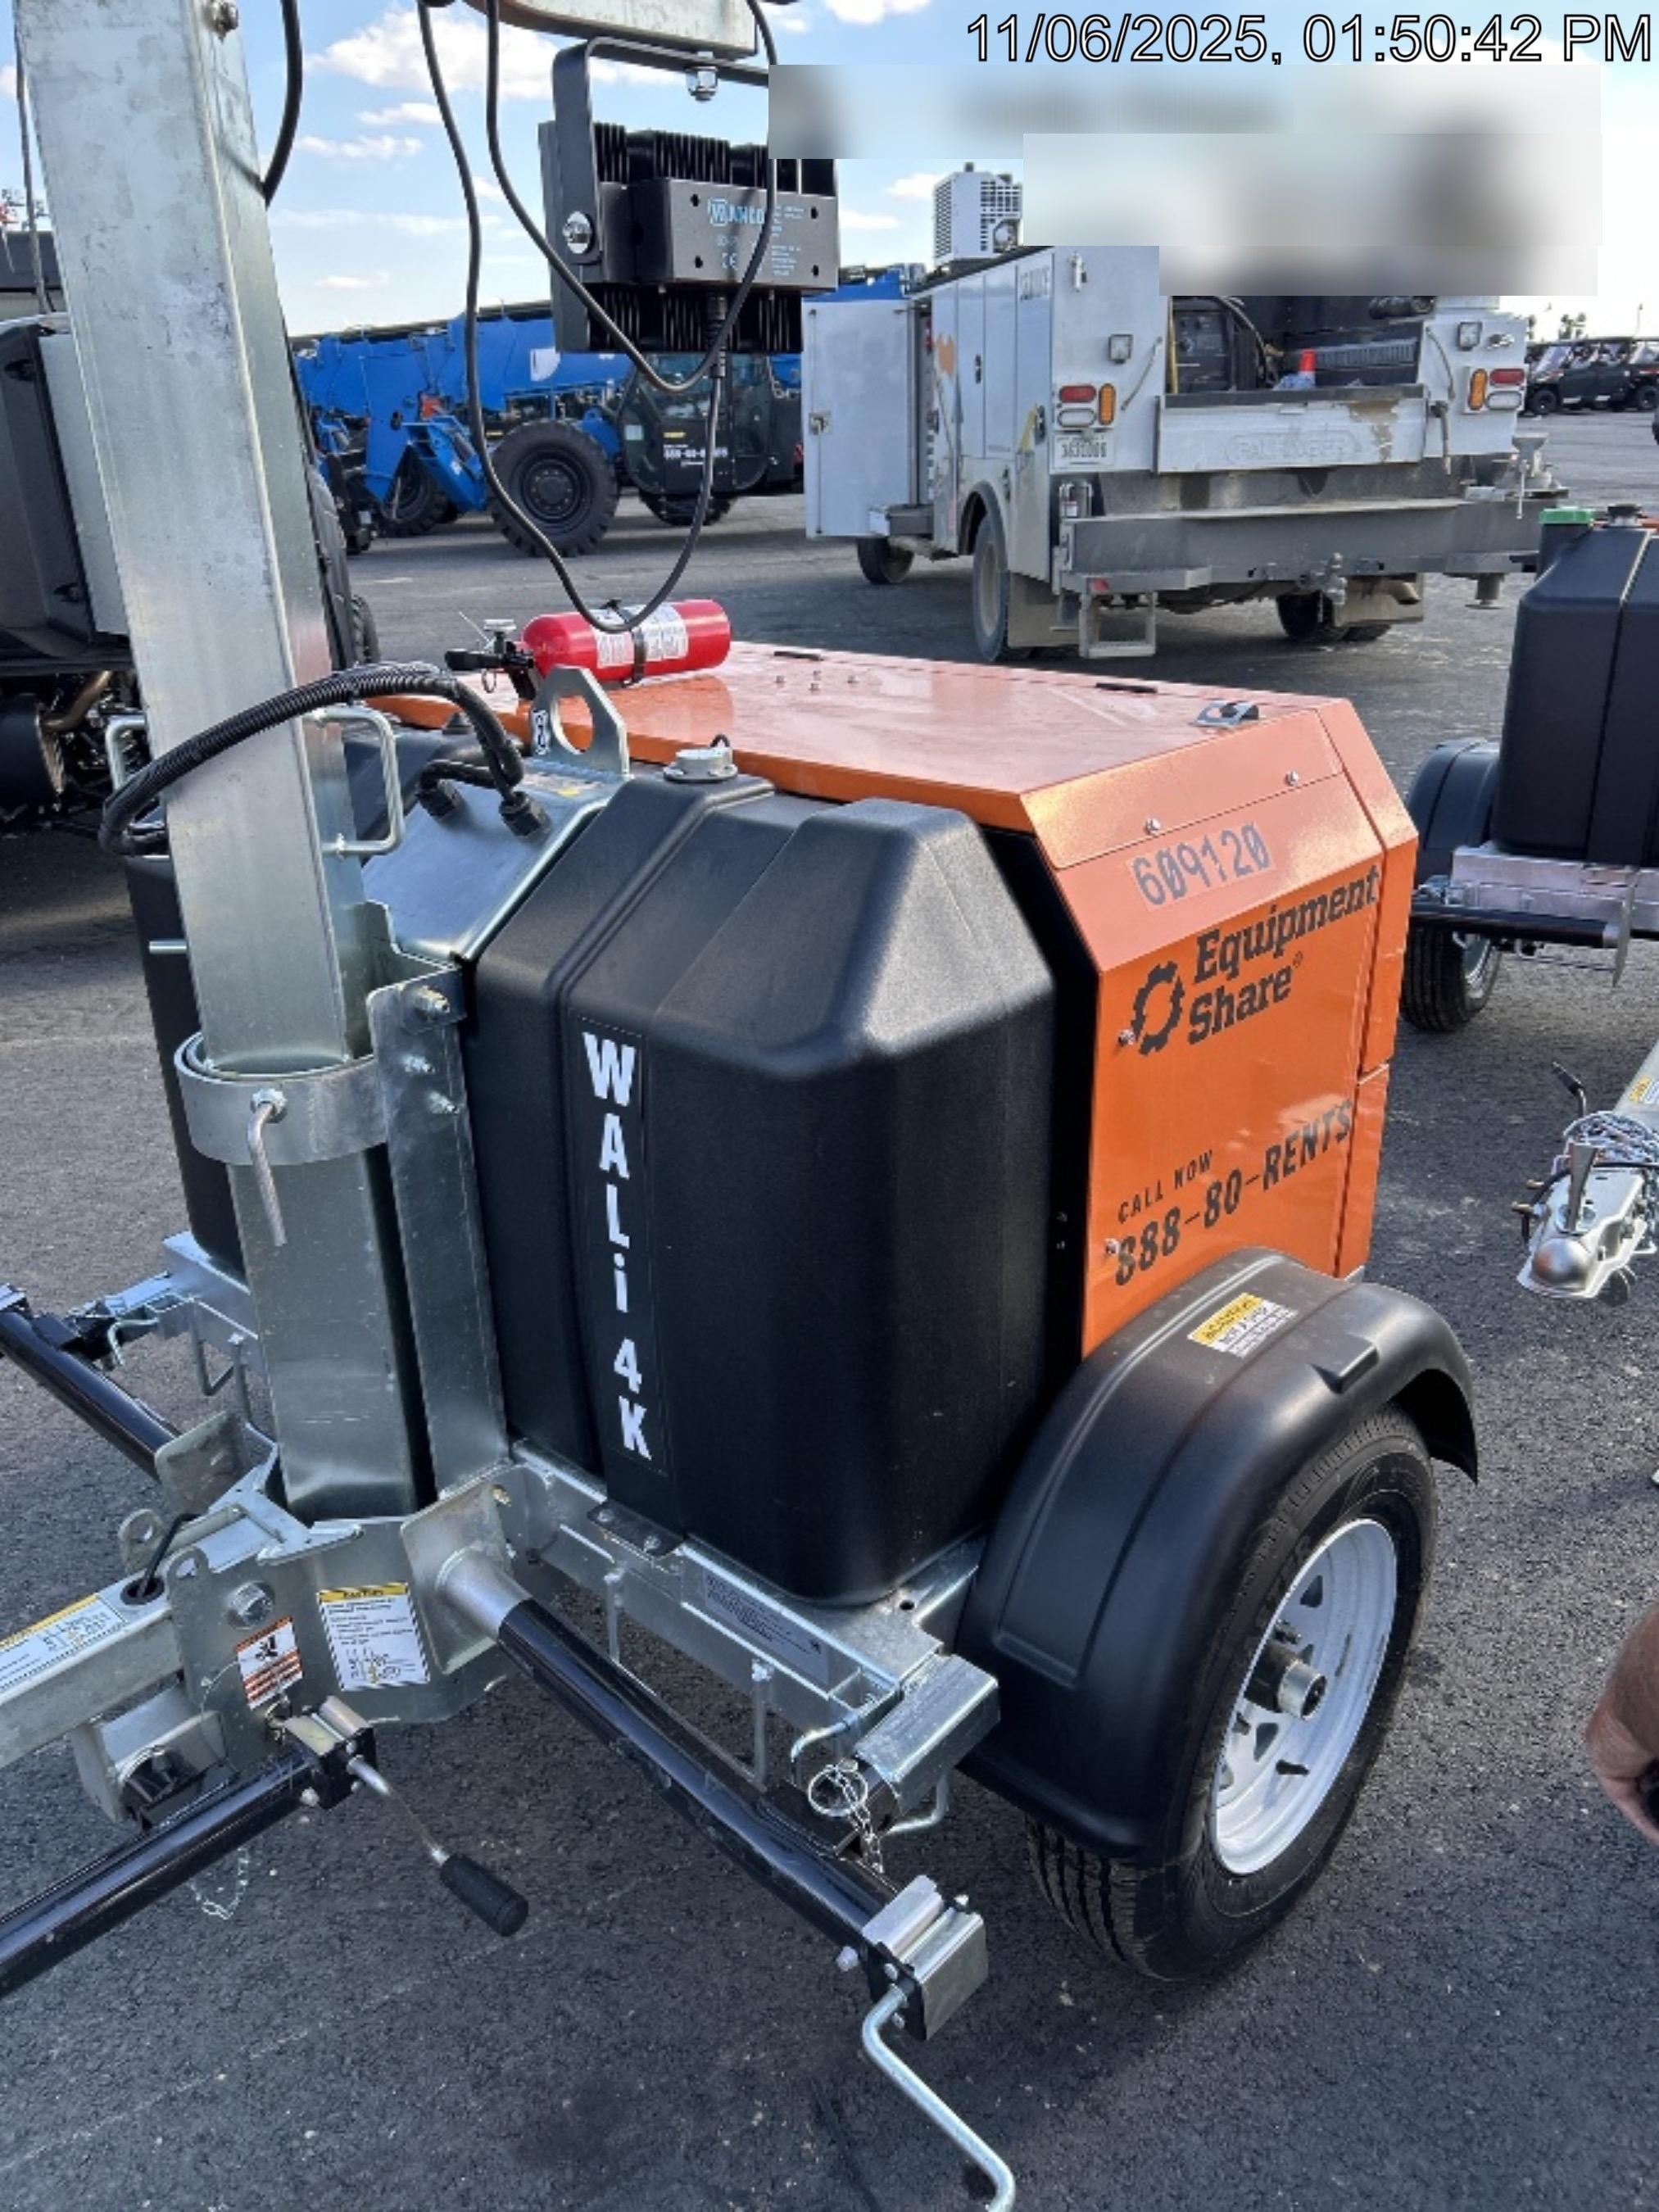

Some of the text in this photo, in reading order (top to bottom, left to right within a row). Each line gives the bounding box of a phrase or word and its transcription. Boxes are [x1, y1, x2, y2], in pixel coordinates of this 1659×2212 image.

[1131, 821, 1271, 905] 609120
[1193, 864, 1379, 984] Equipment
[1114, 1099, 1353, 1288] 888-80-RENTS
[1117, 1149, 1213, 1225] CALL NOW
[613, 1337, 653, 1461] 4K
